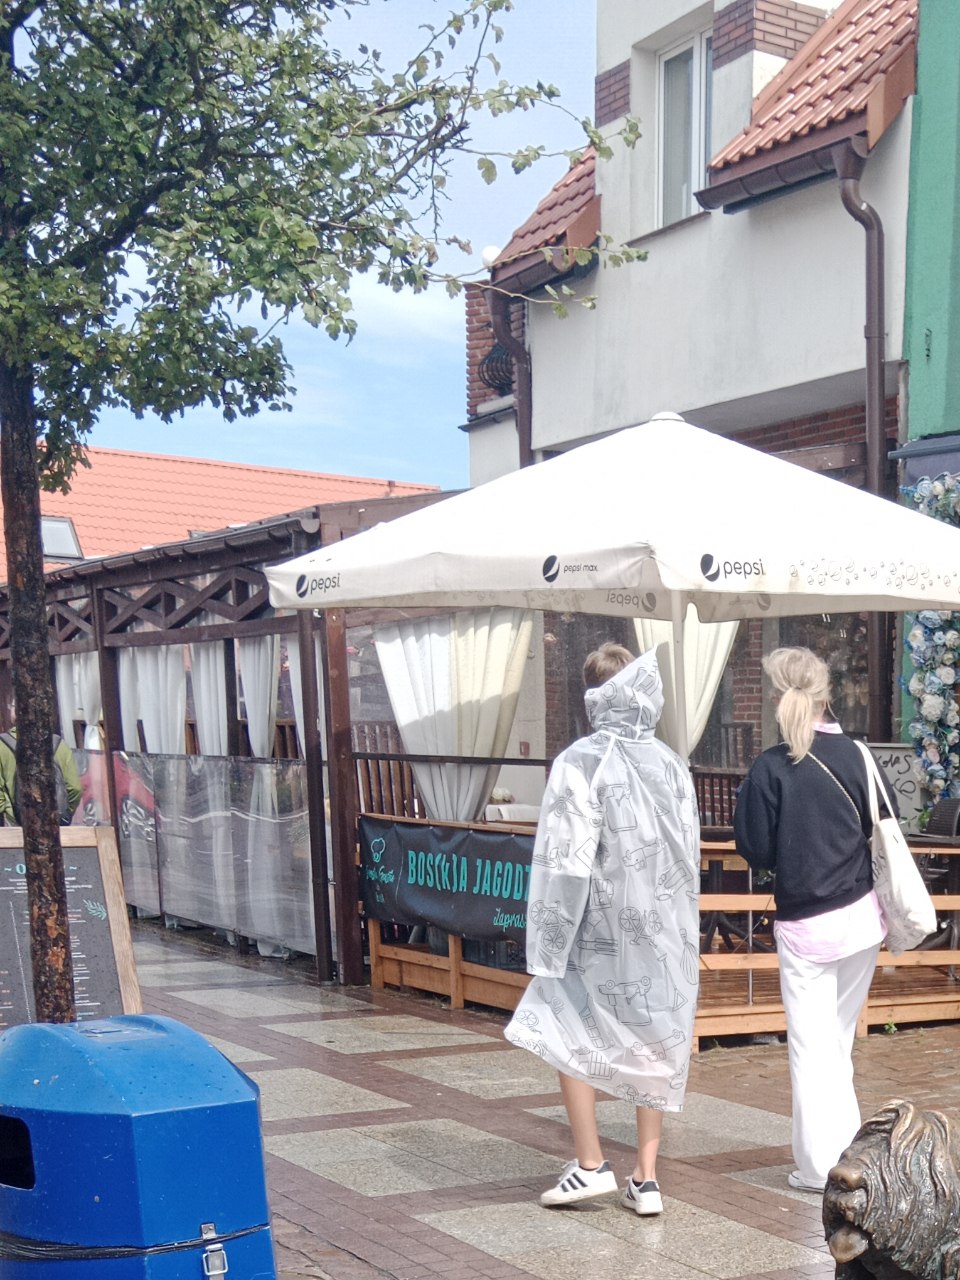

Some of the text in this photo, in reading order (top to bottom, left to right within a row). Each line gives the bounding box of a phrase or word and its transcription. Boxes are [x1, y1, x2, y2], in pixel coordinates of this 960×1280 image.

[563, 564, 598, 574] pepsi max
[723, 559, 765, 580] pepsi
[310, 572, 341, 592] pepsi
[493, 907, 528, 932] Zapras
